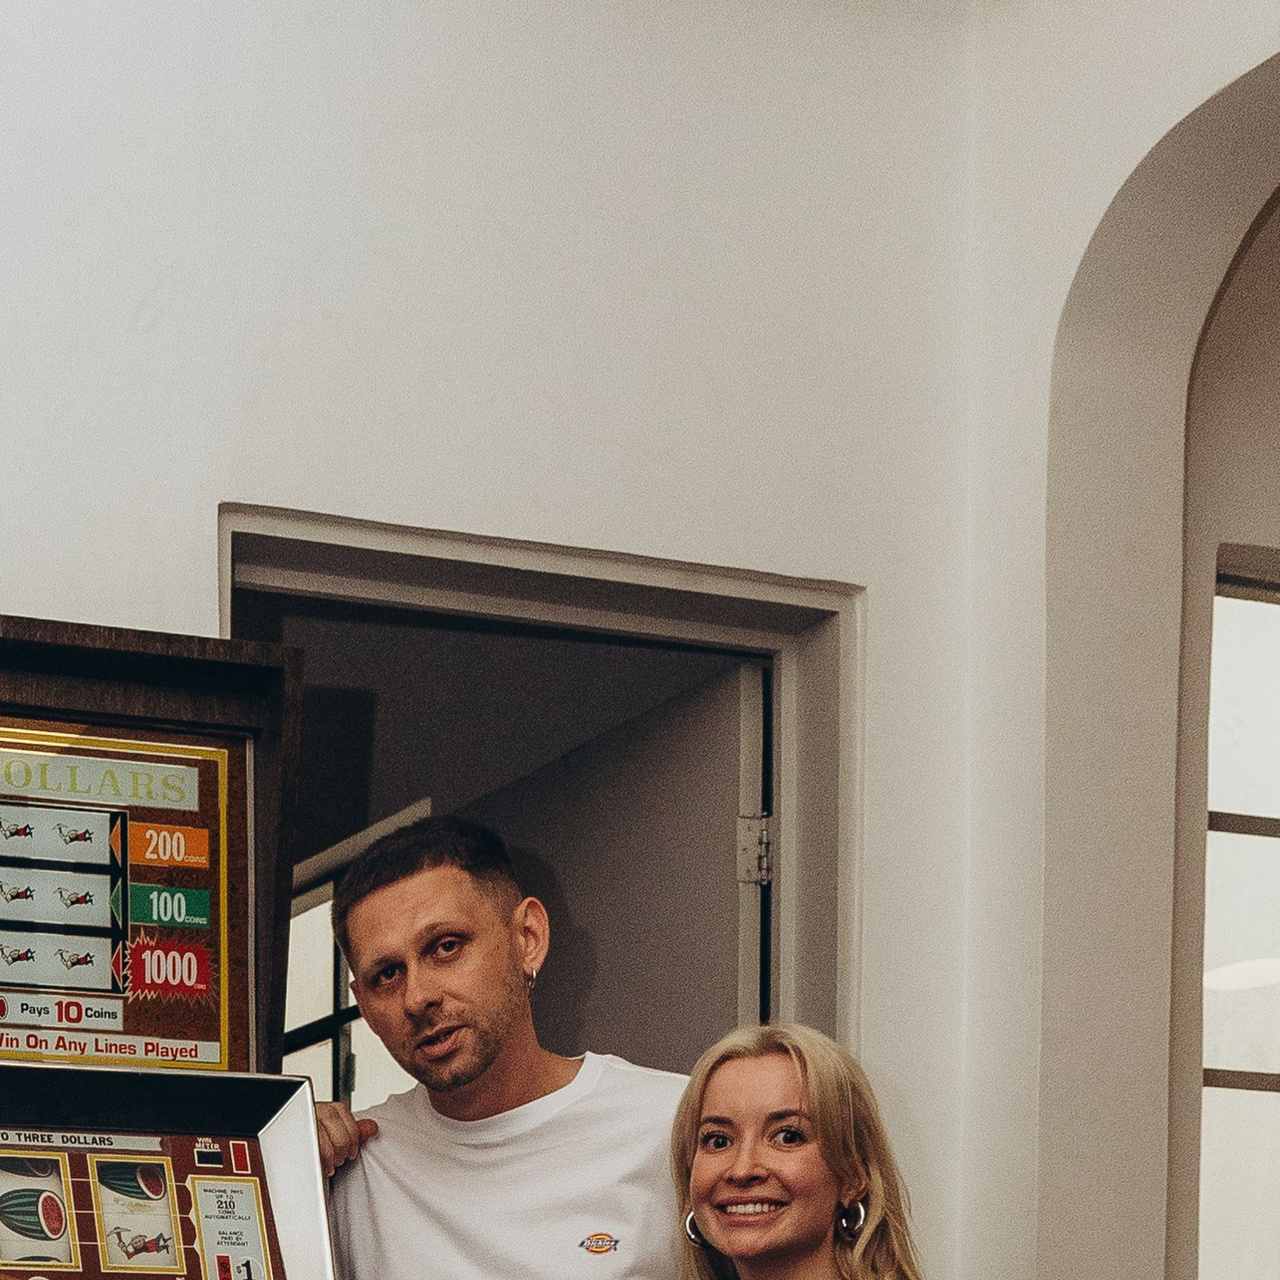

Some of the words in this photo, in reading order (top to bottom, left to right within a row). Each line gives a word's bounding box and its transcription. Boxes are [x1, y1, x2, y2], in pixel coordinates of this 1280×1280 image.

[145, 829, 185, 862] 200
[150, 891, 186, 922] 100
[185, 916, 207, 924] COINS
[142, 950, 198, 987] 1000
[20, 1002, 50, 1018] Pays
[54, 1000, 83, 1024] 10
[84, 1007, 118, 1020] Coins
[26, 1033, 49, 1050] On
[54, 1035, 87, 1055] Any
[94, 1038, 137, 1055] Lines
[144, 1042, 198, 1061] Played
[15, 1132, 54, 1144] THREE
[61, 1135, 114, 1146] DOLLARS
[216, 1200, 236, 1210] 210
